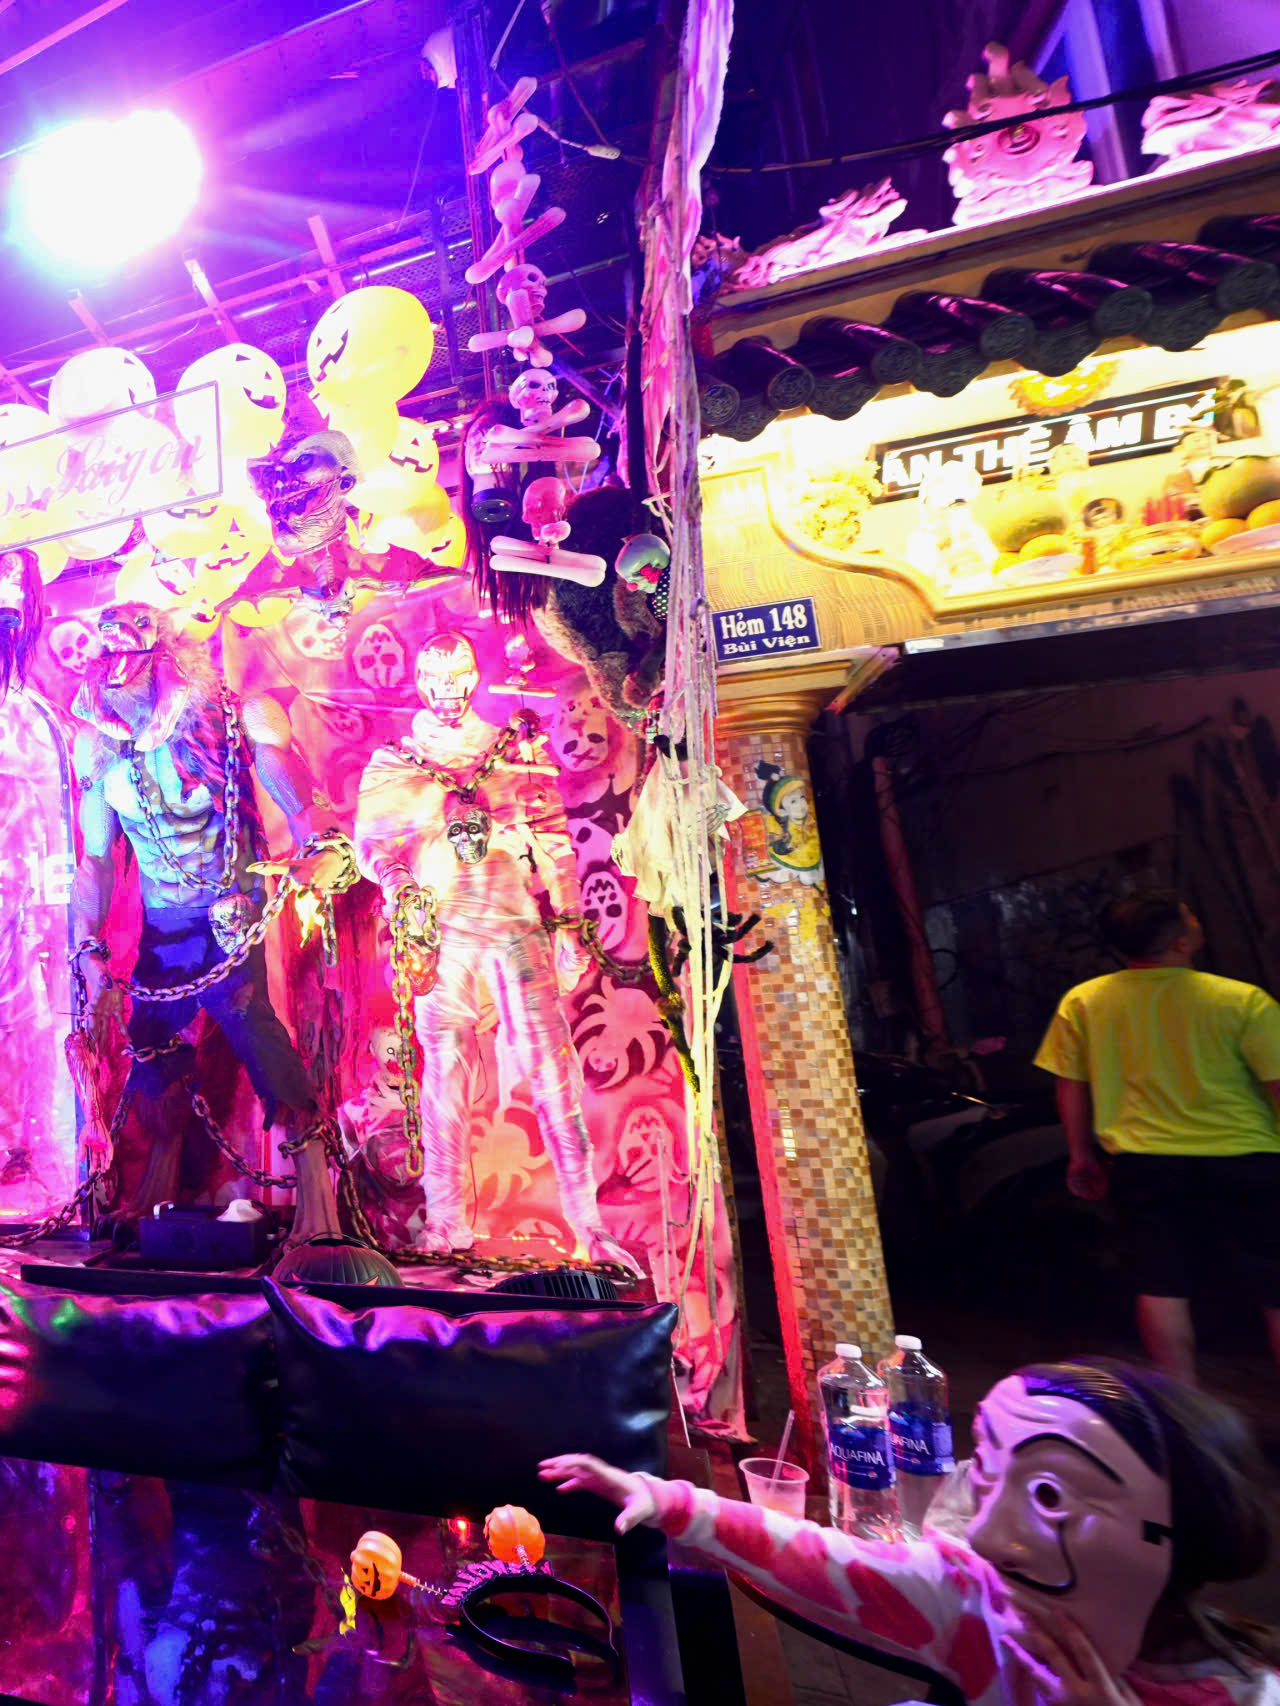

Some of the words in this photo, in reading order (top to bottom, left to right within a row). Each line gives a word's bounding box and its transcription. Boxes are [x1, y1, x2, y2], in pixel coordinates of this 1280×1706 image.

[720, 612, 766, 639] Hẻm
[769, 603, 808, 632] 148
[723, 640, 758, 655] Bùi
[762, 634, 811, 649] Viện
[830, 1441, 886, 1467] AQUAFINA
